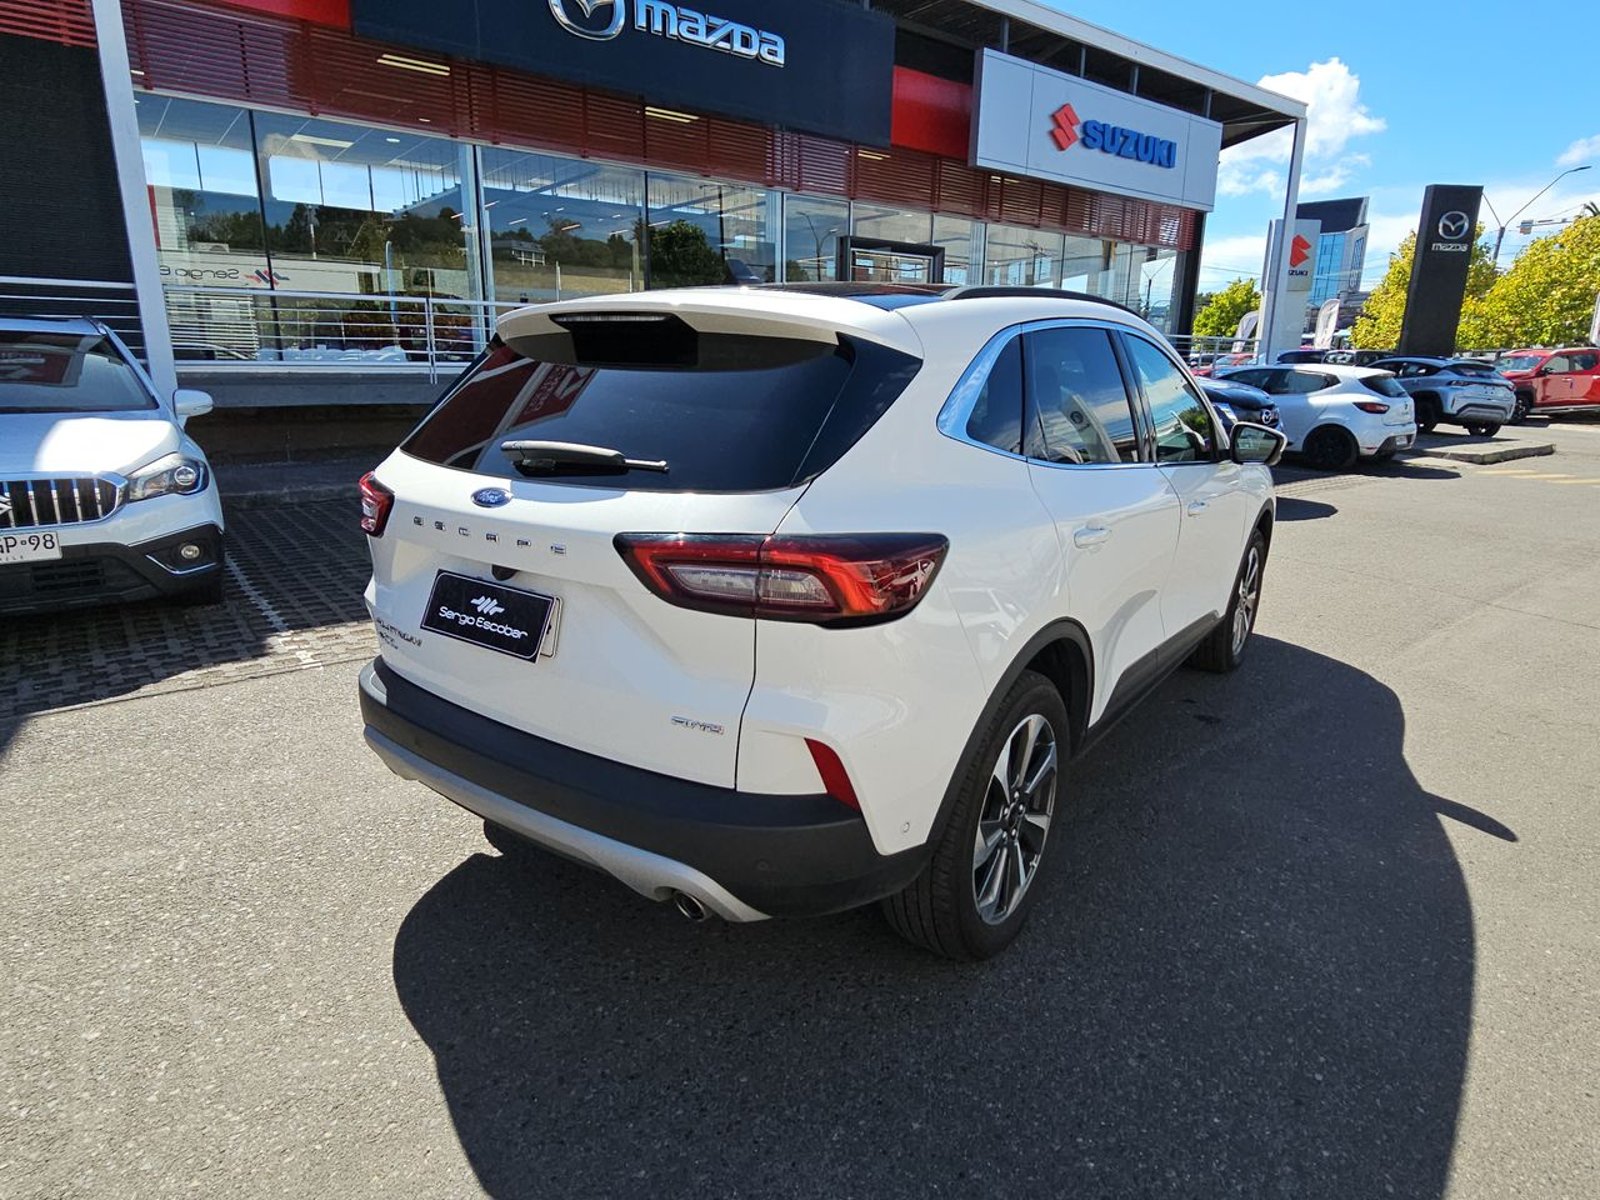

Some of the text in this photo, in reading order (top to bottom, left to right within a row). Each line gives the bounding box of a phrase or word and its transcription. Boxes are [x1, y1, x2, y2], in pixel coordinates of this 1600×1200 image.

[1082, 119, 1176, 168] SUZUKI
[413, 515, 567, 555] ESCAPE
[475, 616, 529, 639] Escobar
